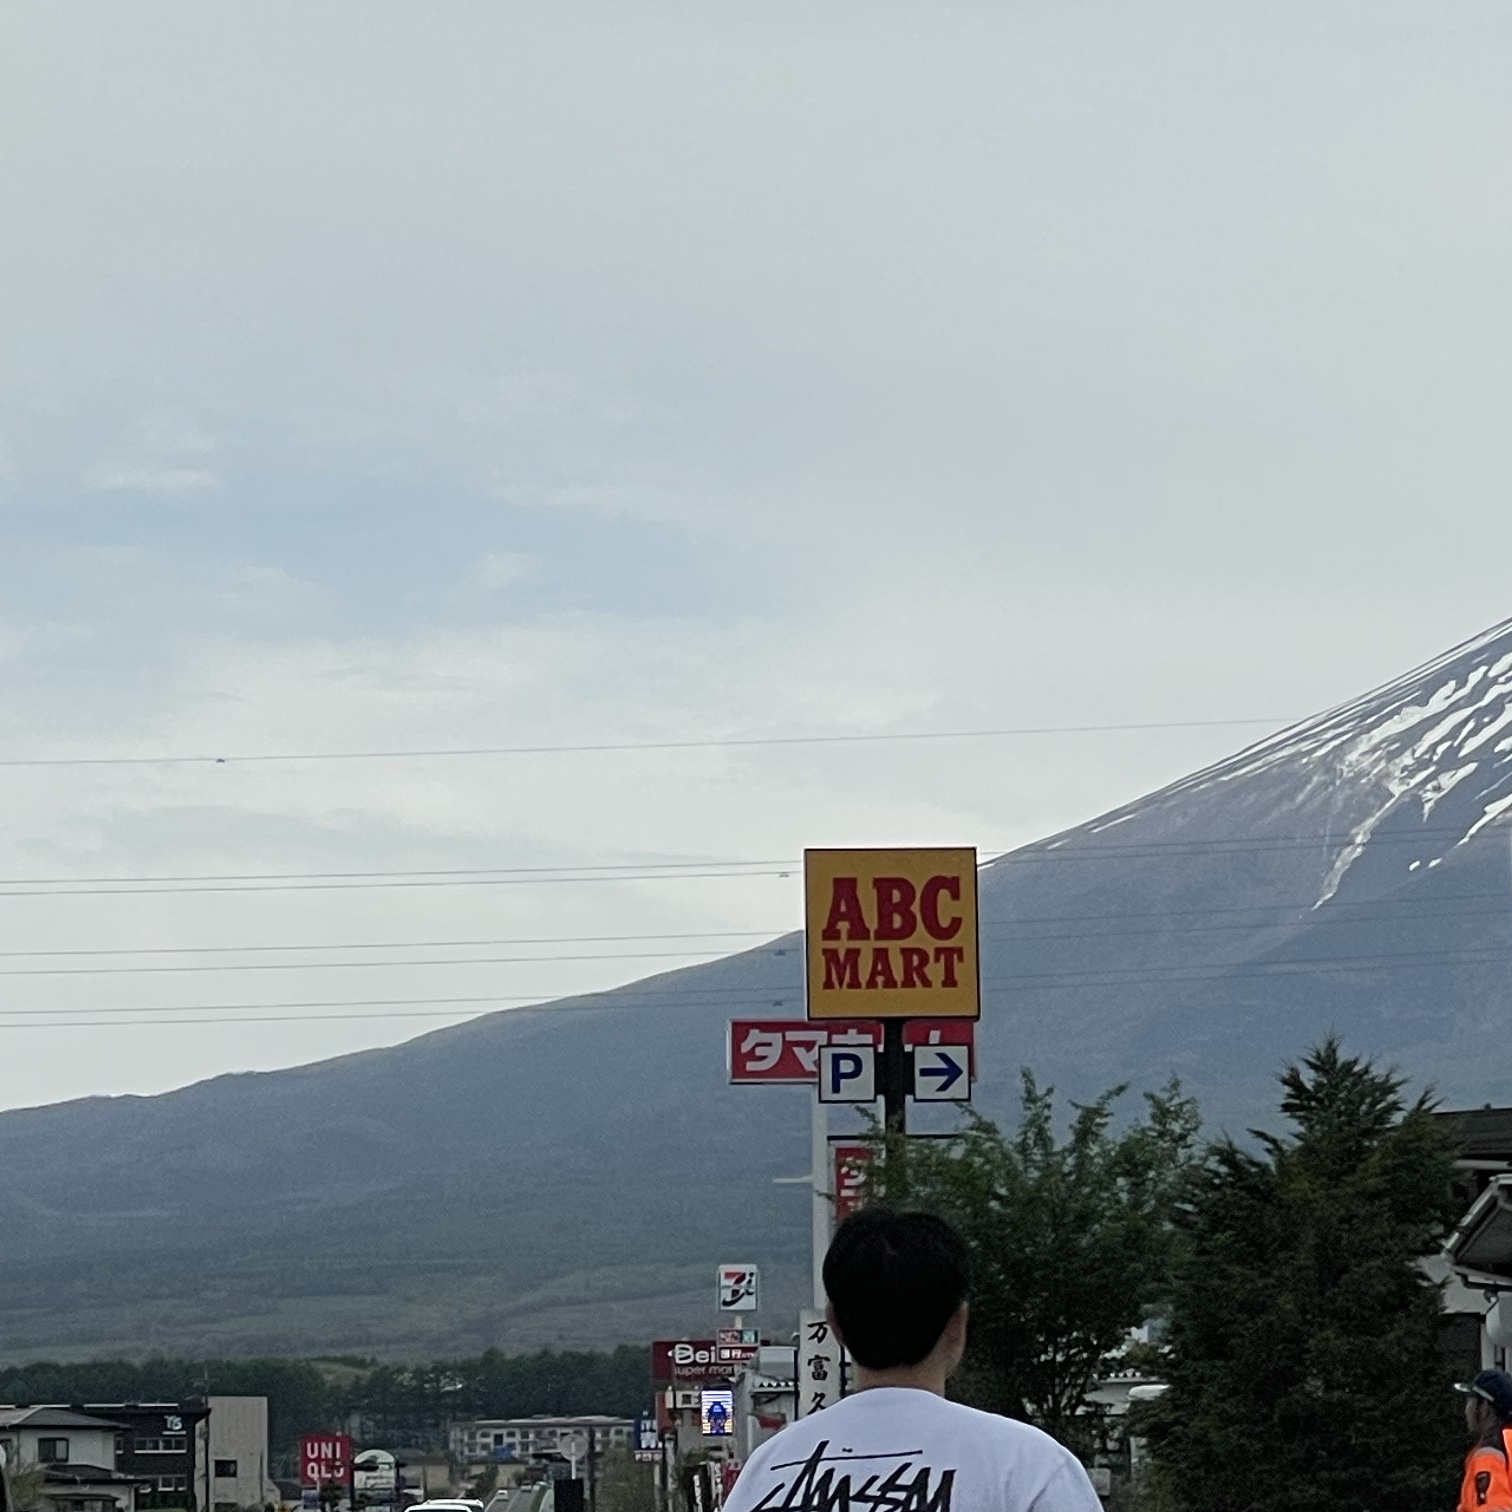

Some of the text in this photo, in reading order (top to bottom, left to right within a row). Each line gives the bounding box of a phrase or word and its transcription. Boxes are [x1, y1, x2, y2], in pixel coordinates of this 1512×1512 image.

[821, 874, 963, 942] ABC
[821, 946, 965, 990] MART
[830, 1052, 863, 1094] P
[674, 1343, 717, 1365] Bei
[306, 1441, 341, 1459] UNI
